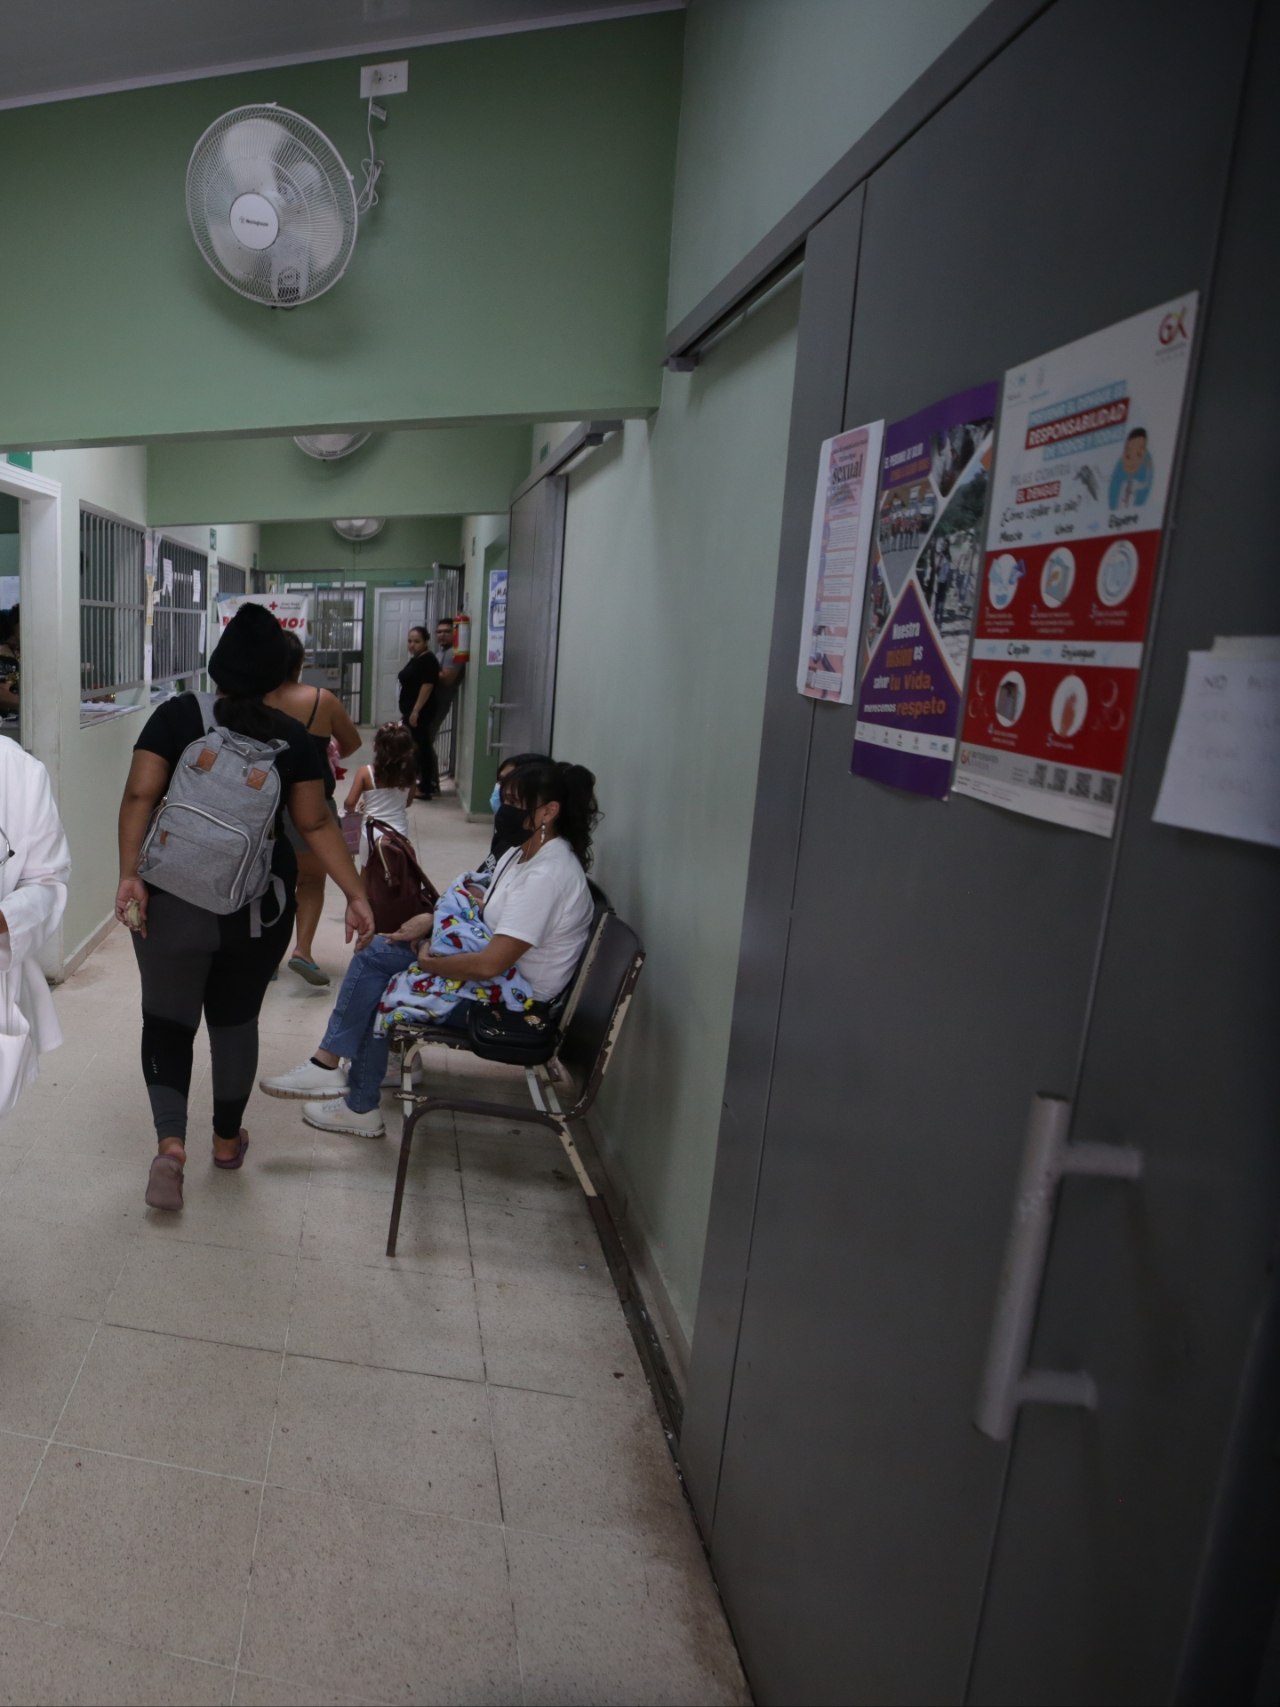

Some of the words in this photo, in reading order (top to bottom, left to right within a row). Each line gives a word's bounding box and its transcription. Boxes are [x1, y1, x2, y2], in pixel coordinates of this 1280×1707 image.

[1030, 404, 1126, 445] RESPONSABILIDAD
[831, 454, 863, 485] sexual
[892, 622, 920, 640] Nuestra
[890, 673, 901, 691] tu
[896, 696, 946, 719] respeto
